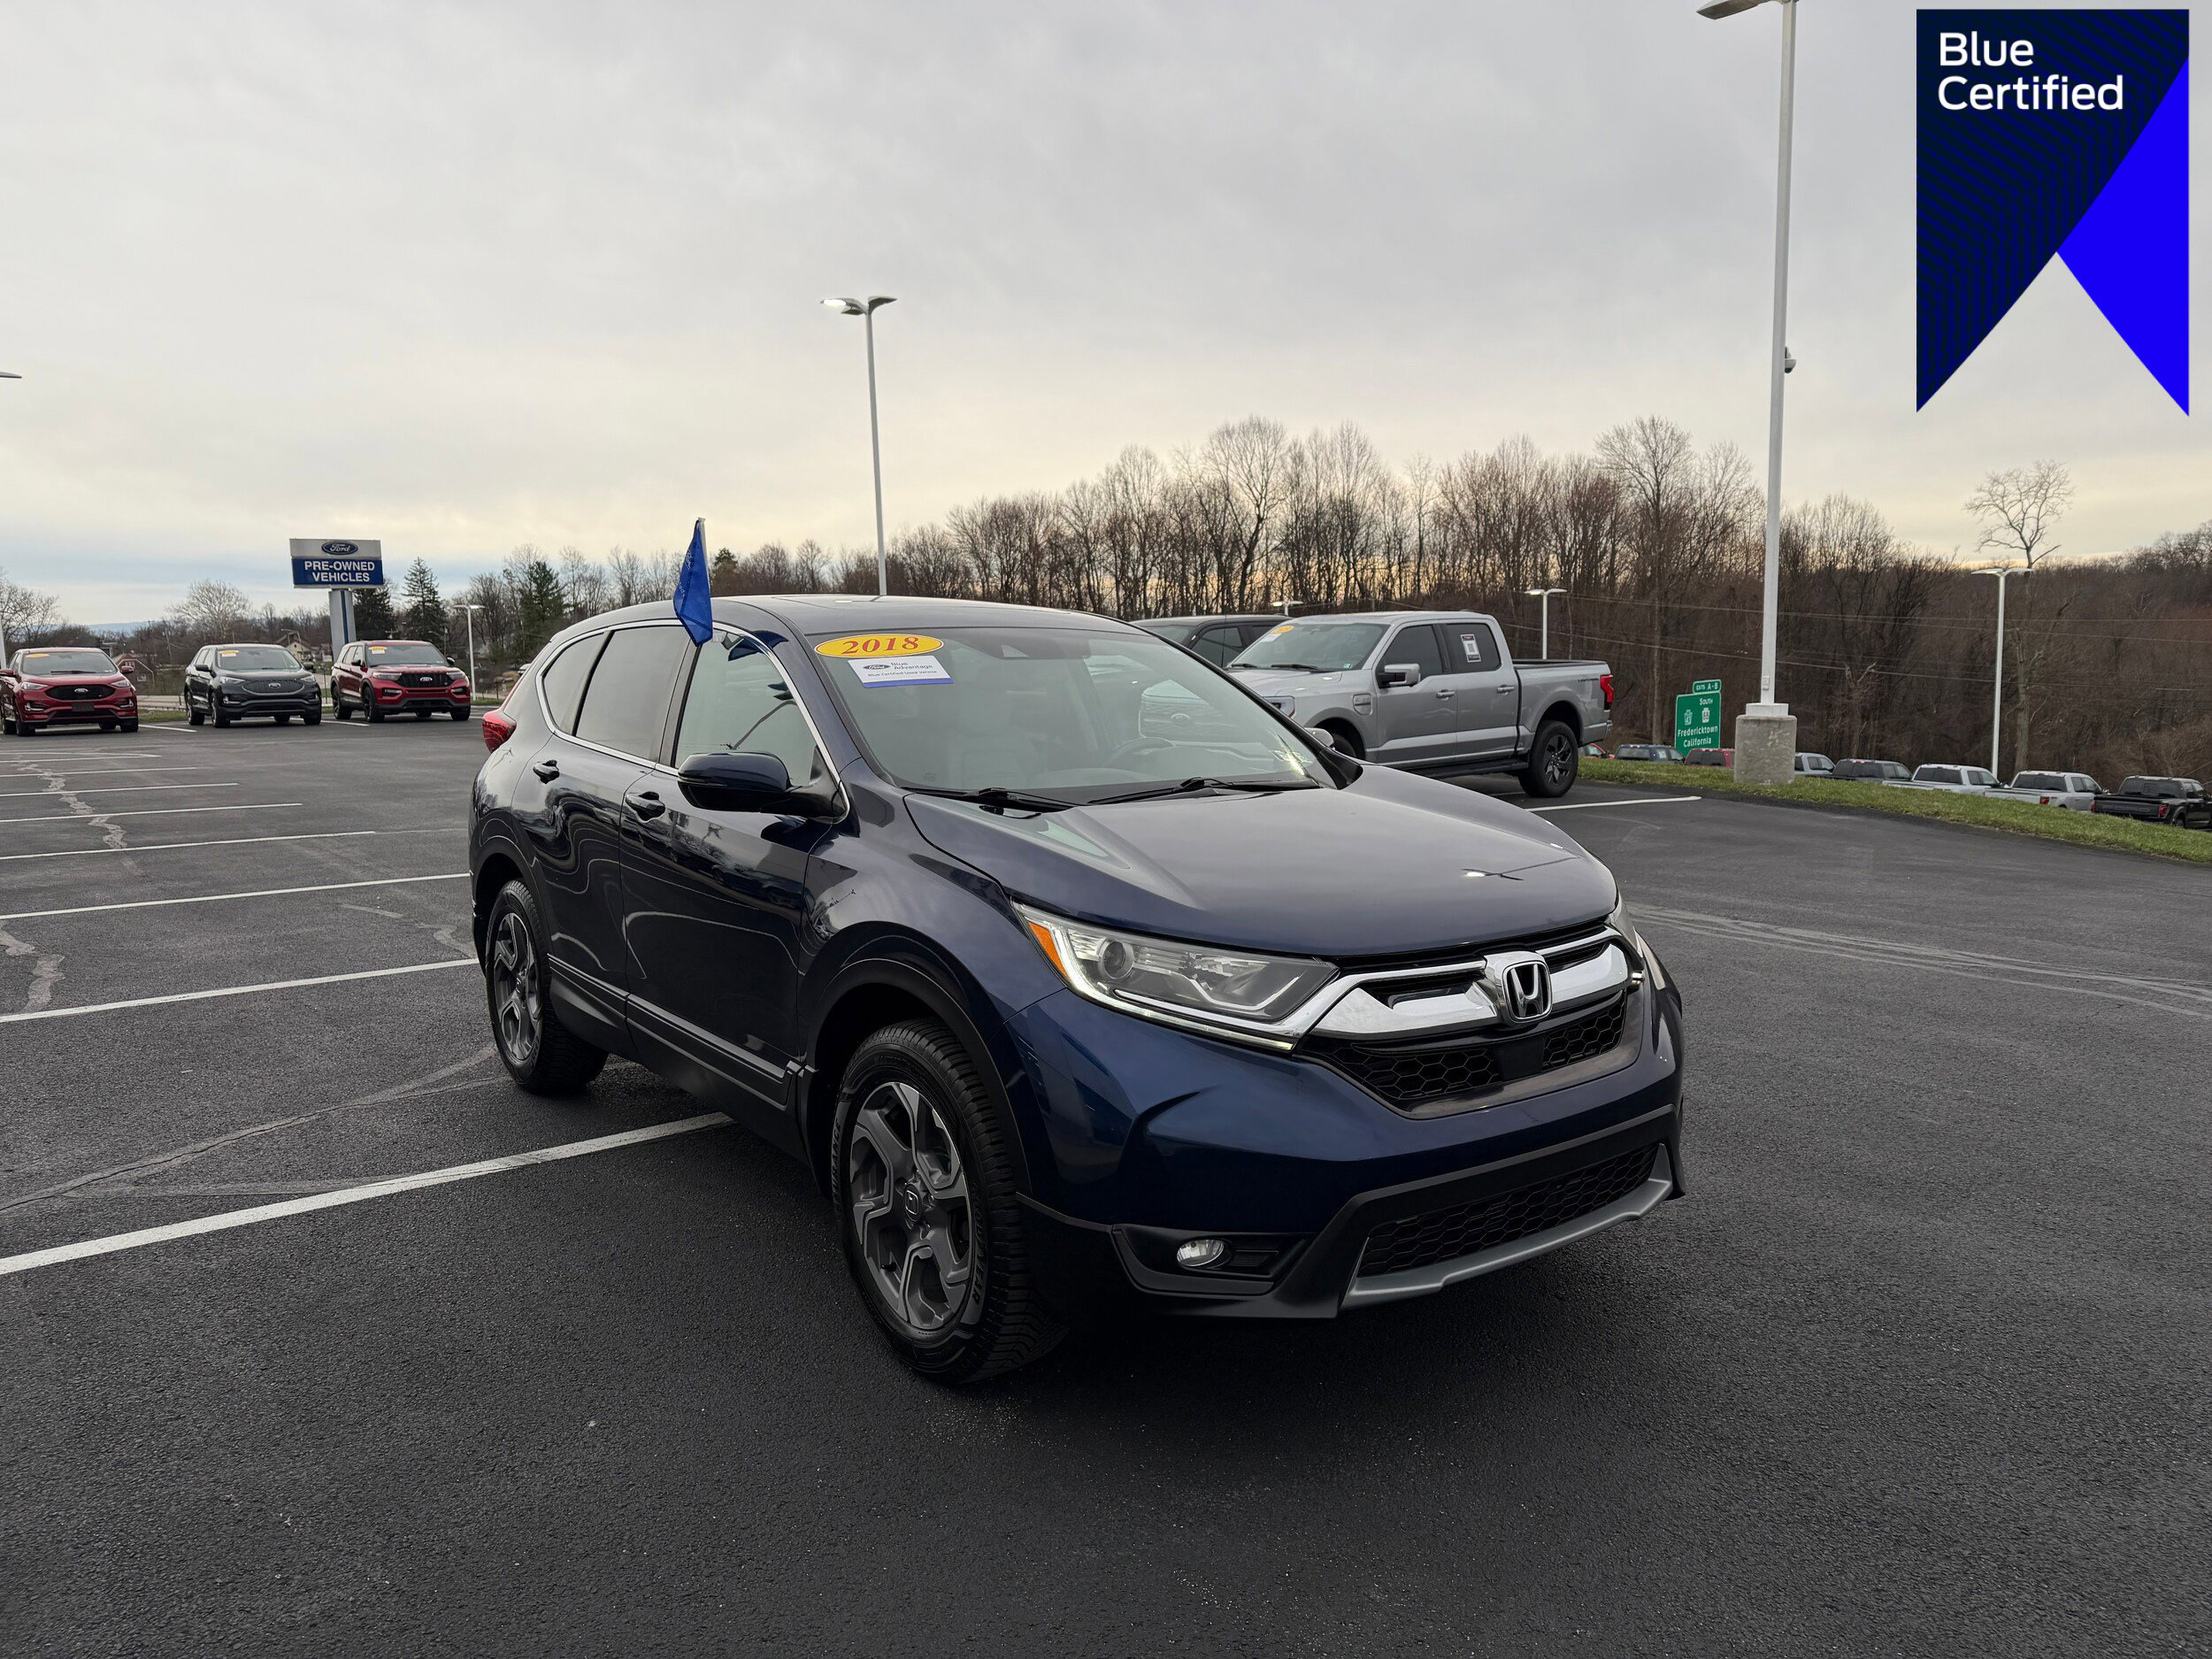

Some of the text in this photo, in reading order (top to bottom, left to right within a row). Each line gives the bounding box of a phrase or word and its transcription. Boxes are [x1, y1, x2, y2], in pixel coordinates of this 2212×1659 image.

[329, 543, 351, 552] Ford
[304, 560, 375, 572] PRE-OWNED
[312, 572, 370, 582] VEHICLES
[841, 636, 918, 655] 2018
[1678, 726, 1718, 737] Fredericktown
[1684, 737, 1711, 748] California
